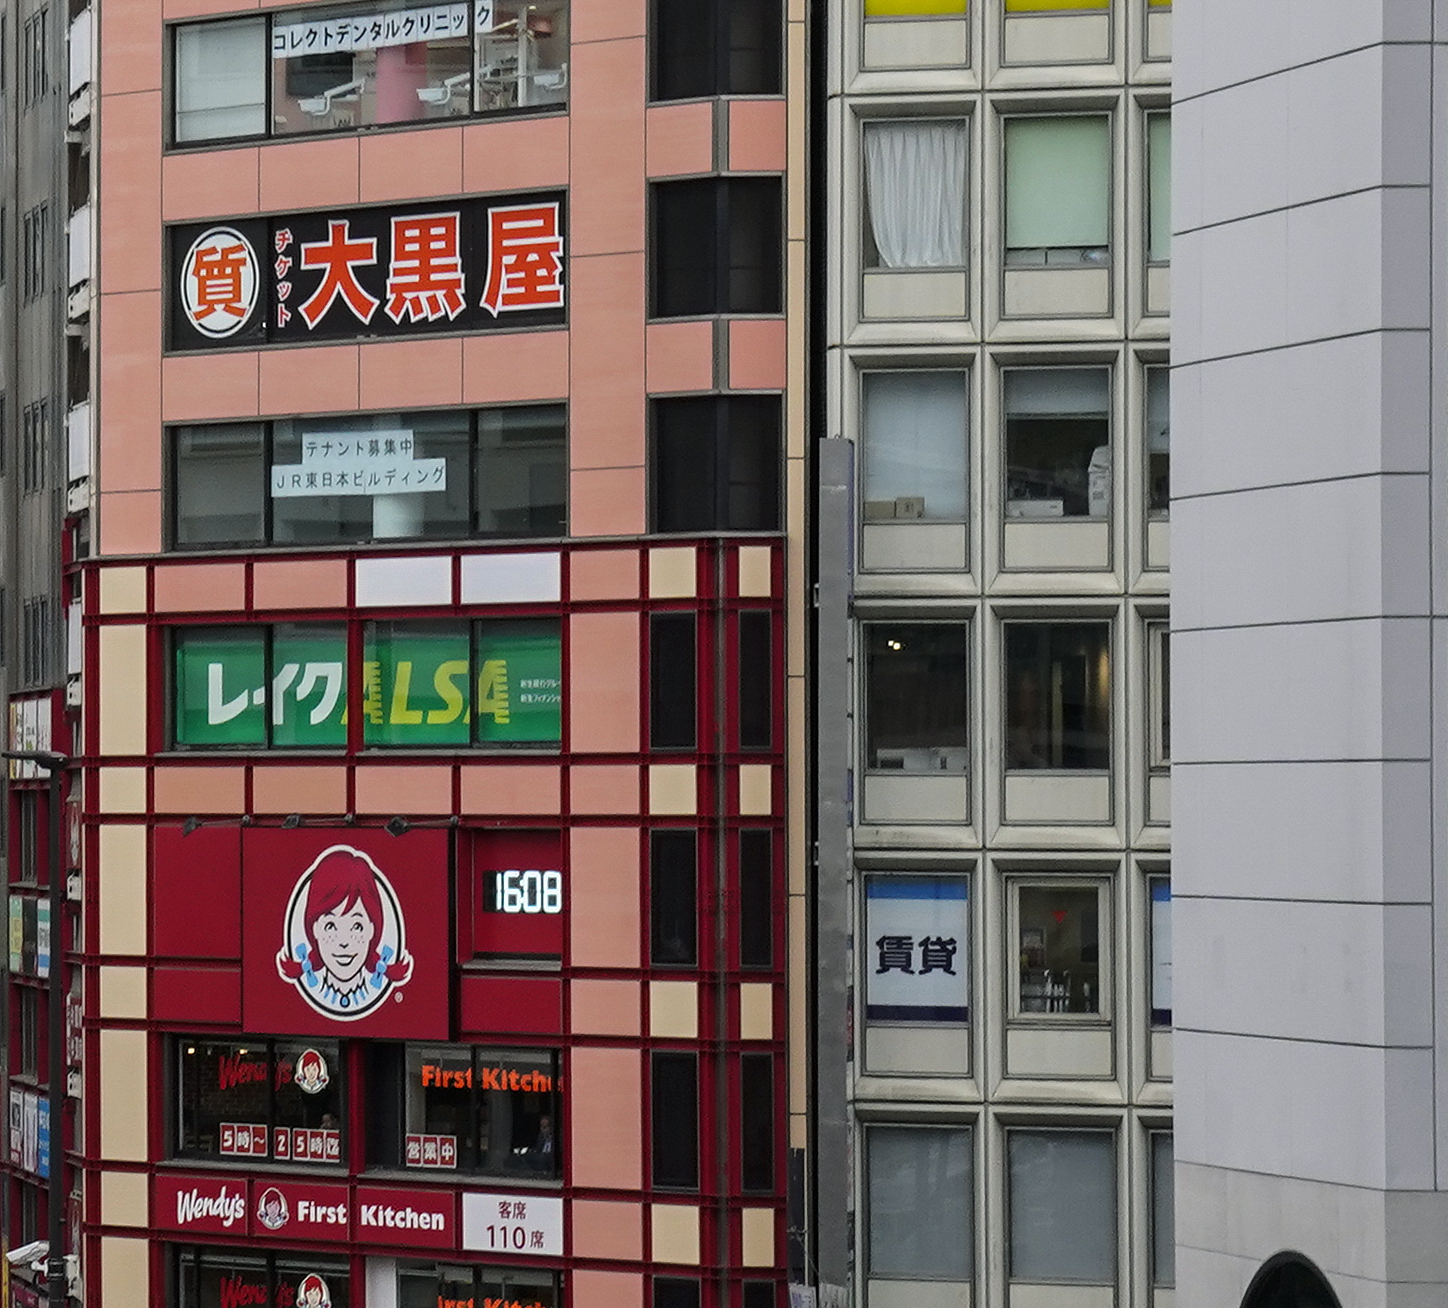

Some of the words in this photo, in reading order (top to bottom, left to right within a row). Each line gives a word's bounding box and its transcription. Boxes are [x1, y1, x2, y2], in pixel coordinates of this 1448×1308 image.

[272, 3, 493, 53] コレクトデンタルクリニック
[191, 241, 249, 324] 質
[274, 228, 293, 328] チケット
[298, 202, 565, 332] 大黒屋
[304, 438, 414, 459] テナント募集中
[275, 466, 447, 492] JR東日本ビルディング
[495, 869, 562, 914] 16:08
[875, 935, 958, 976] 賃貸
[421, 1064, 474, 1090] First
[176, 1186, 246, 1228] Wendy's
[297, 1200, 348, 1225] First
[360, 1203, 445, 1232] Kitchen
[497, 1201, 527, 1221] 客席
[485, 1223, 545, 1251] 110席
